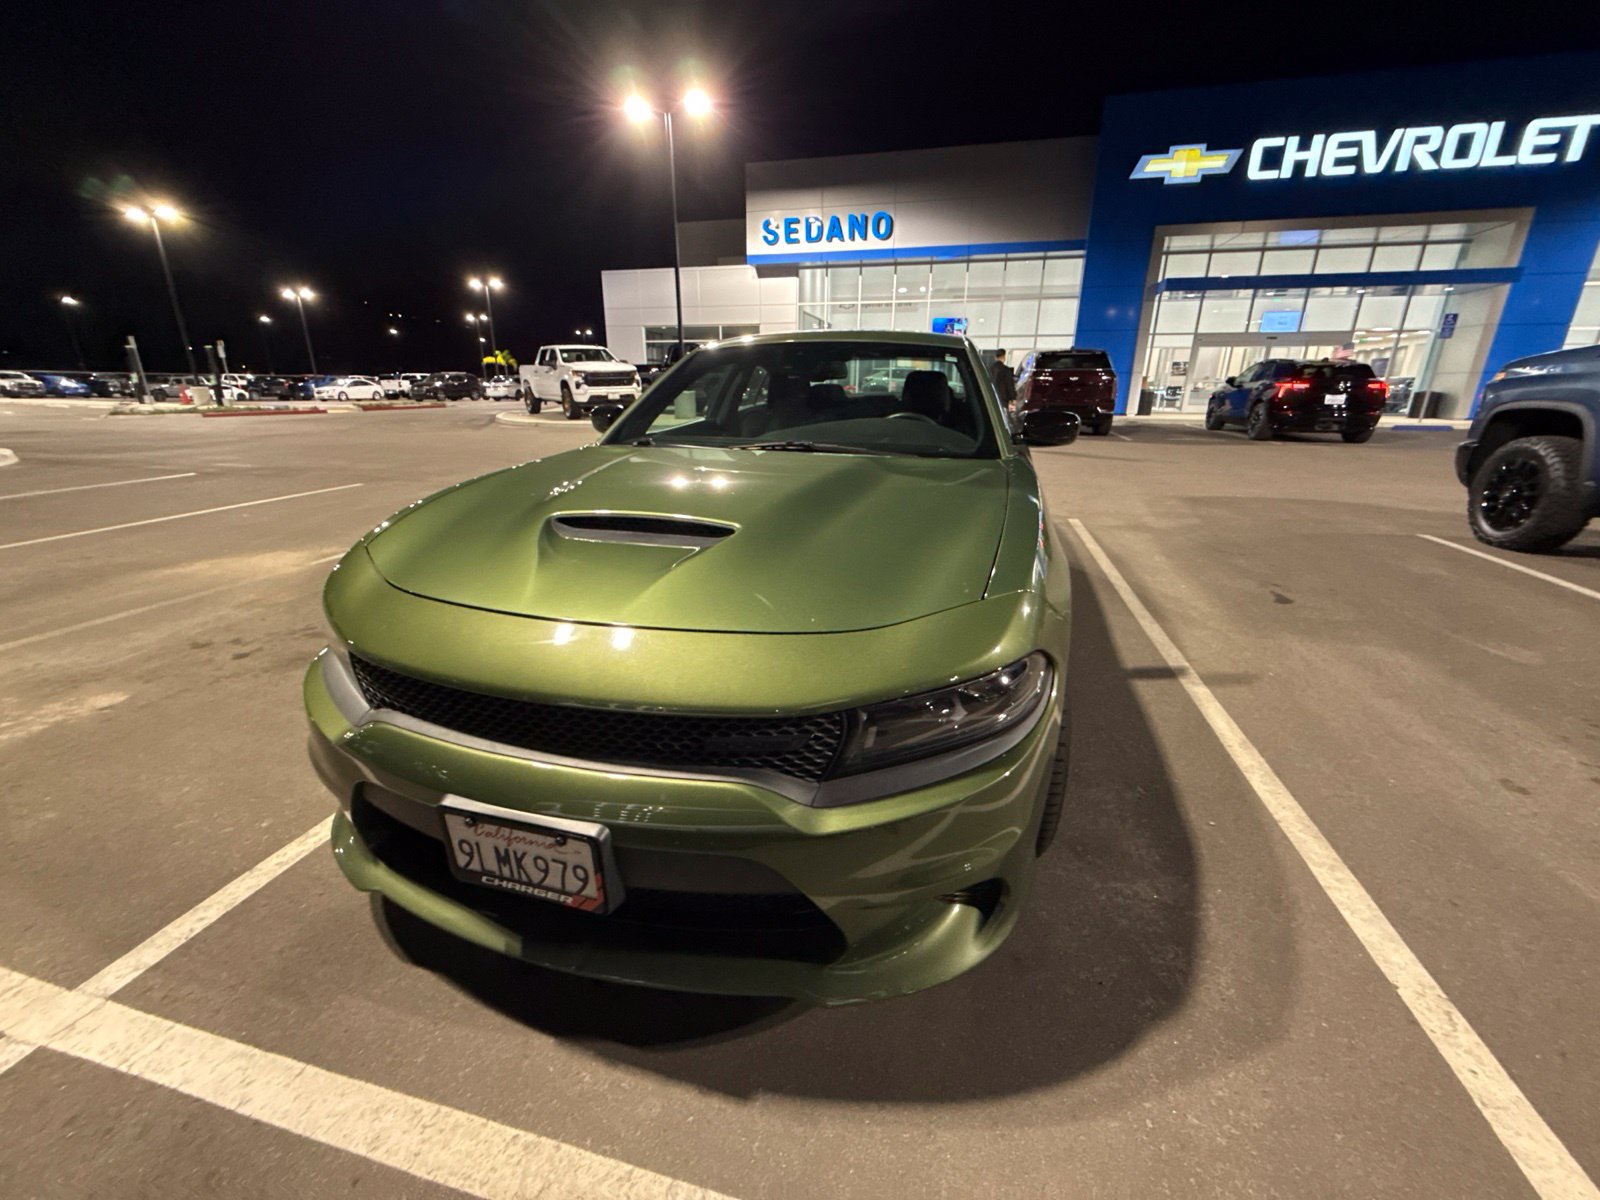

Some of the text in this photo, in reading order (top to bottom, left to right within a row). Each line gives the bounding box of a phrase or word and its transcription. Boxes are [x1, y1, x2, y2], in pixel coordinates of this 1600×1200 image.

[1247, 114, 1600, 181] CHEVROLET
[762, 211, 894, 246] SEDANO
[471, 822, 560, 850] California
[457, 839, 590, 896] 9LMK979
[481, 875, 574, 904] CHARGER
